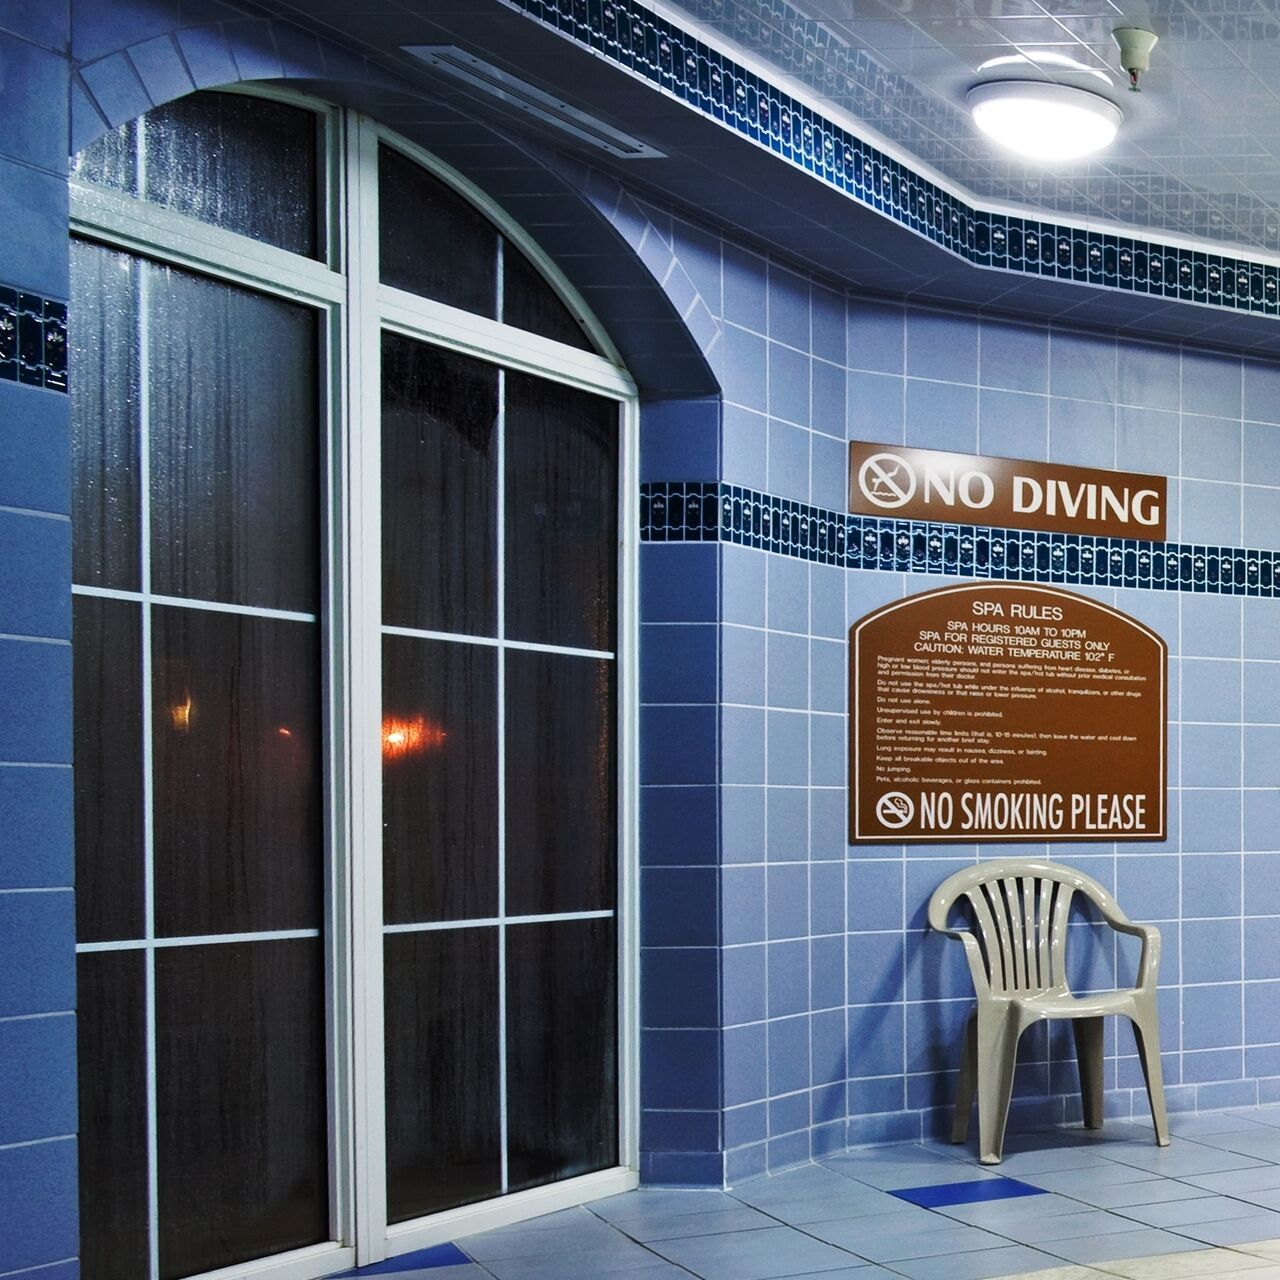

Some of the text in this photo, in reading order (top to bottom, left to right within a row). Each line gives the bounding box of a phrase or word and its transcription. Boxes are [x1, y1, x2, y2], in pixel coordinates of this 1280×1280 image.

[924, 467, 1159, 525] NO DIVING
[972, 600, 1063, 621] SPA RULES
[946, 620, 1086, 639] SPA HOURS 10AM TO 10PM
[913, 641, 1115, 663] CAUTION: WATER TEMPERATURE 102° F
[919, 630, 1110, 652] SPA FOR REGISTERED GUESTS ONLY
[920, 791, 1146, 830] NO SMOKING PLEASE
